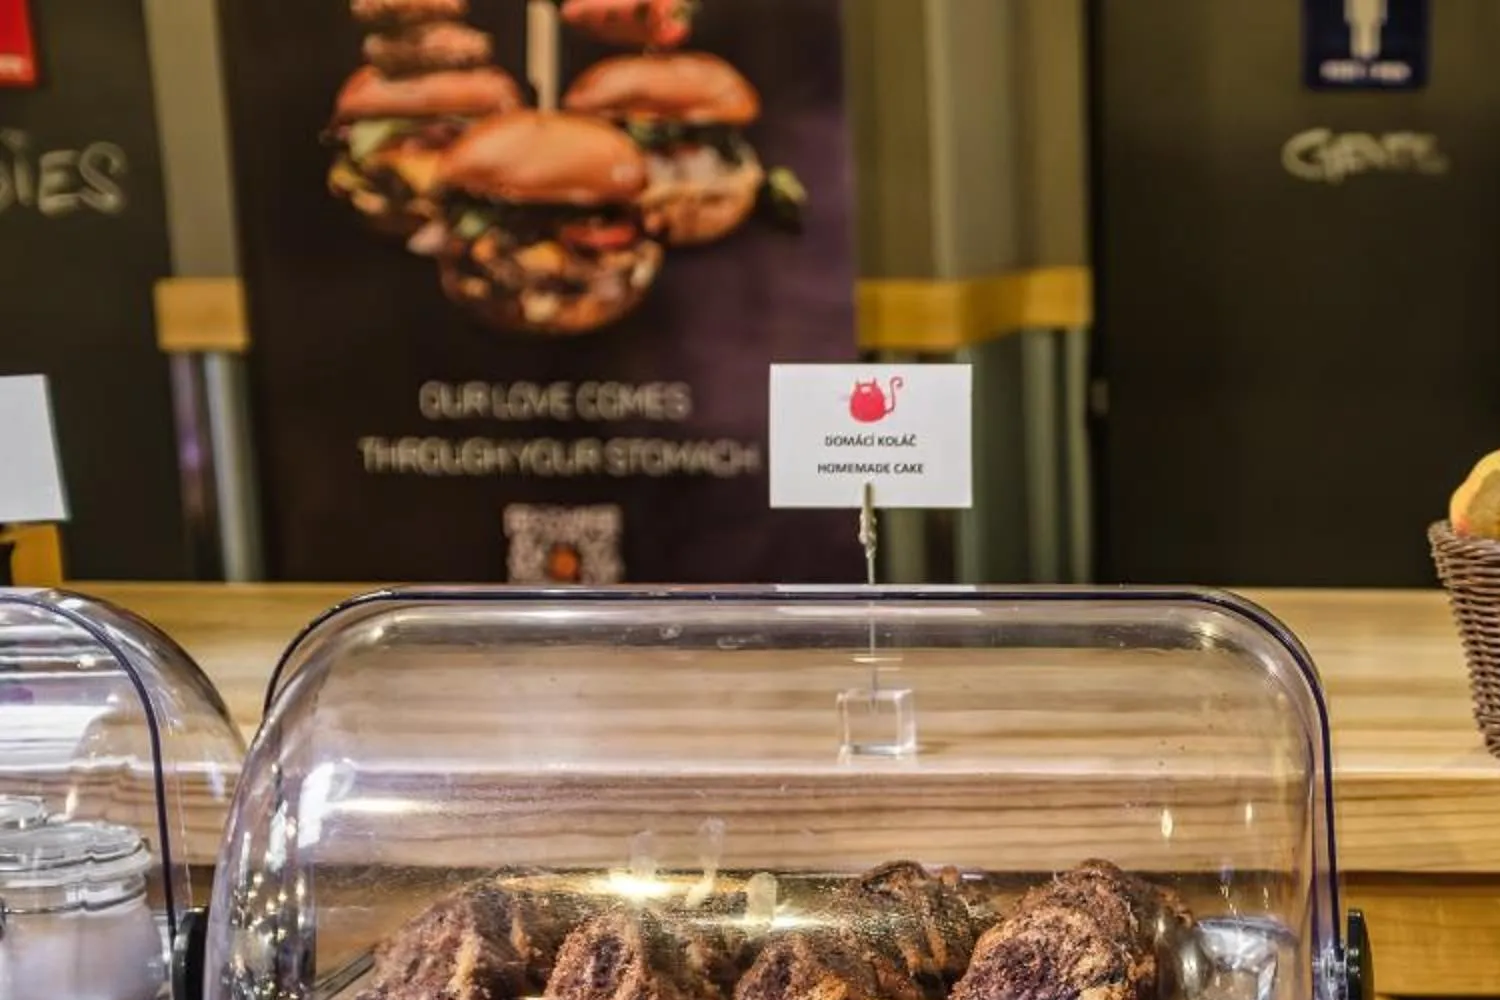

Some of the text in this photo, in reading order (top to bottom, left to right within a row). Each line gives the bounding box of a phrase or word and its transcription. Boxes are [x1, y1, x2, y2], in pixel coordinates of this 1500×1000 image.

[419, 380, 692, 421] OUR LOVE COMES
[825, 434, 916, 447] DOMÁCÍ KOLÁČ
[359, 436, 760, 477] THROUGH YOUR STOMACH
[818, 463, 924, 474] HOMEMADE CAKE
